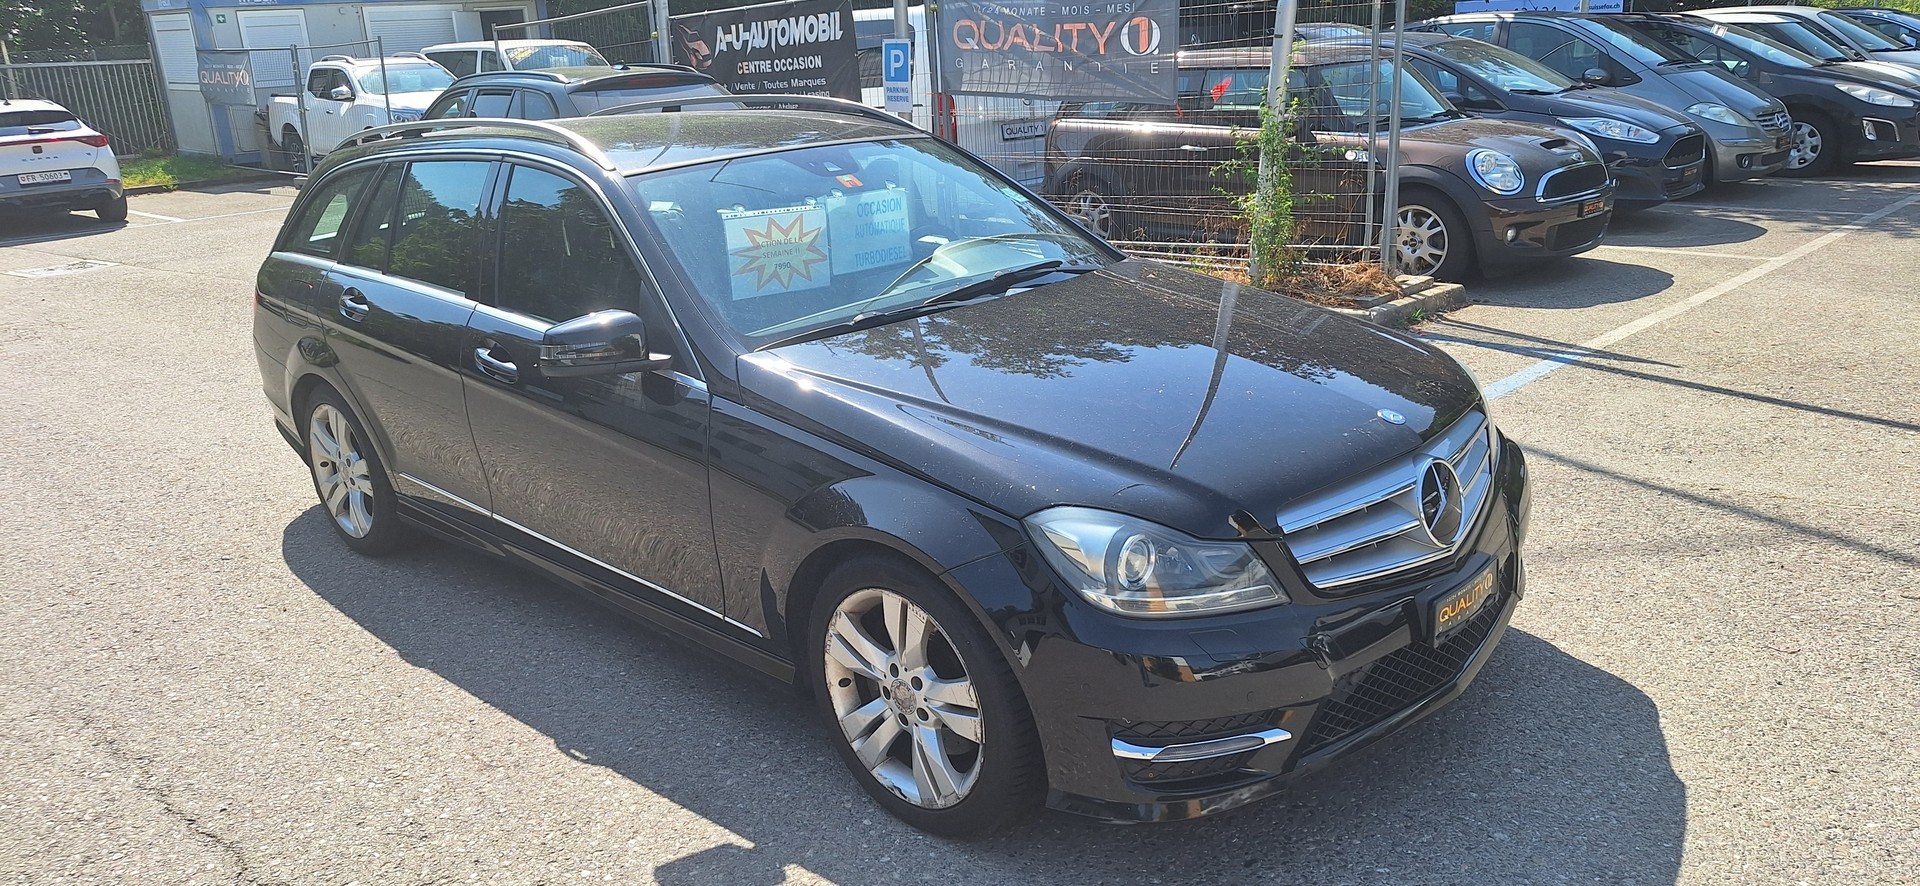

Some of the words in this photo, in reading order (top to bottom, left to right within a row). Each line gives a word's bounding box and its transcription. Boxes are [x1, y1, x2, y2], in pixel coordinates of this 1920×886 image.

[1002, 7, 1046, 16] MONATE
[1061, 5, 1091, 15] MOIS
[1106, 3, 1136, 14] MESI
[713, 11, 844, 59] A-U-AUTOMOBIL
[952, 18, 1116, 55] QUALITY
[737, 59, 772, 75] CENTRE
[773, 55, 822, 73] OCCASION
[890, 49, 905, 78] P
[200, 70, 240, 85] QUALITY
[734, 82, 756, 91] Vente
[763, 79, 789, 89] Toutes
[790, 77, 827, 90] Marques
[886, 86, 909, 94] PARKING
[1005, 125, 1039, 136] QUALITY
[856, 197, 902, 218] OCCASION
[854, 218, 906, 239] AUTOMATIQUE
[762, 248, 794, 259] SEMAINE
[854, 246, 907, 268] TURBODIESEL
[774, 261, 791, 270] 7990
[1439, 580, 1484, 623] QUALITY
